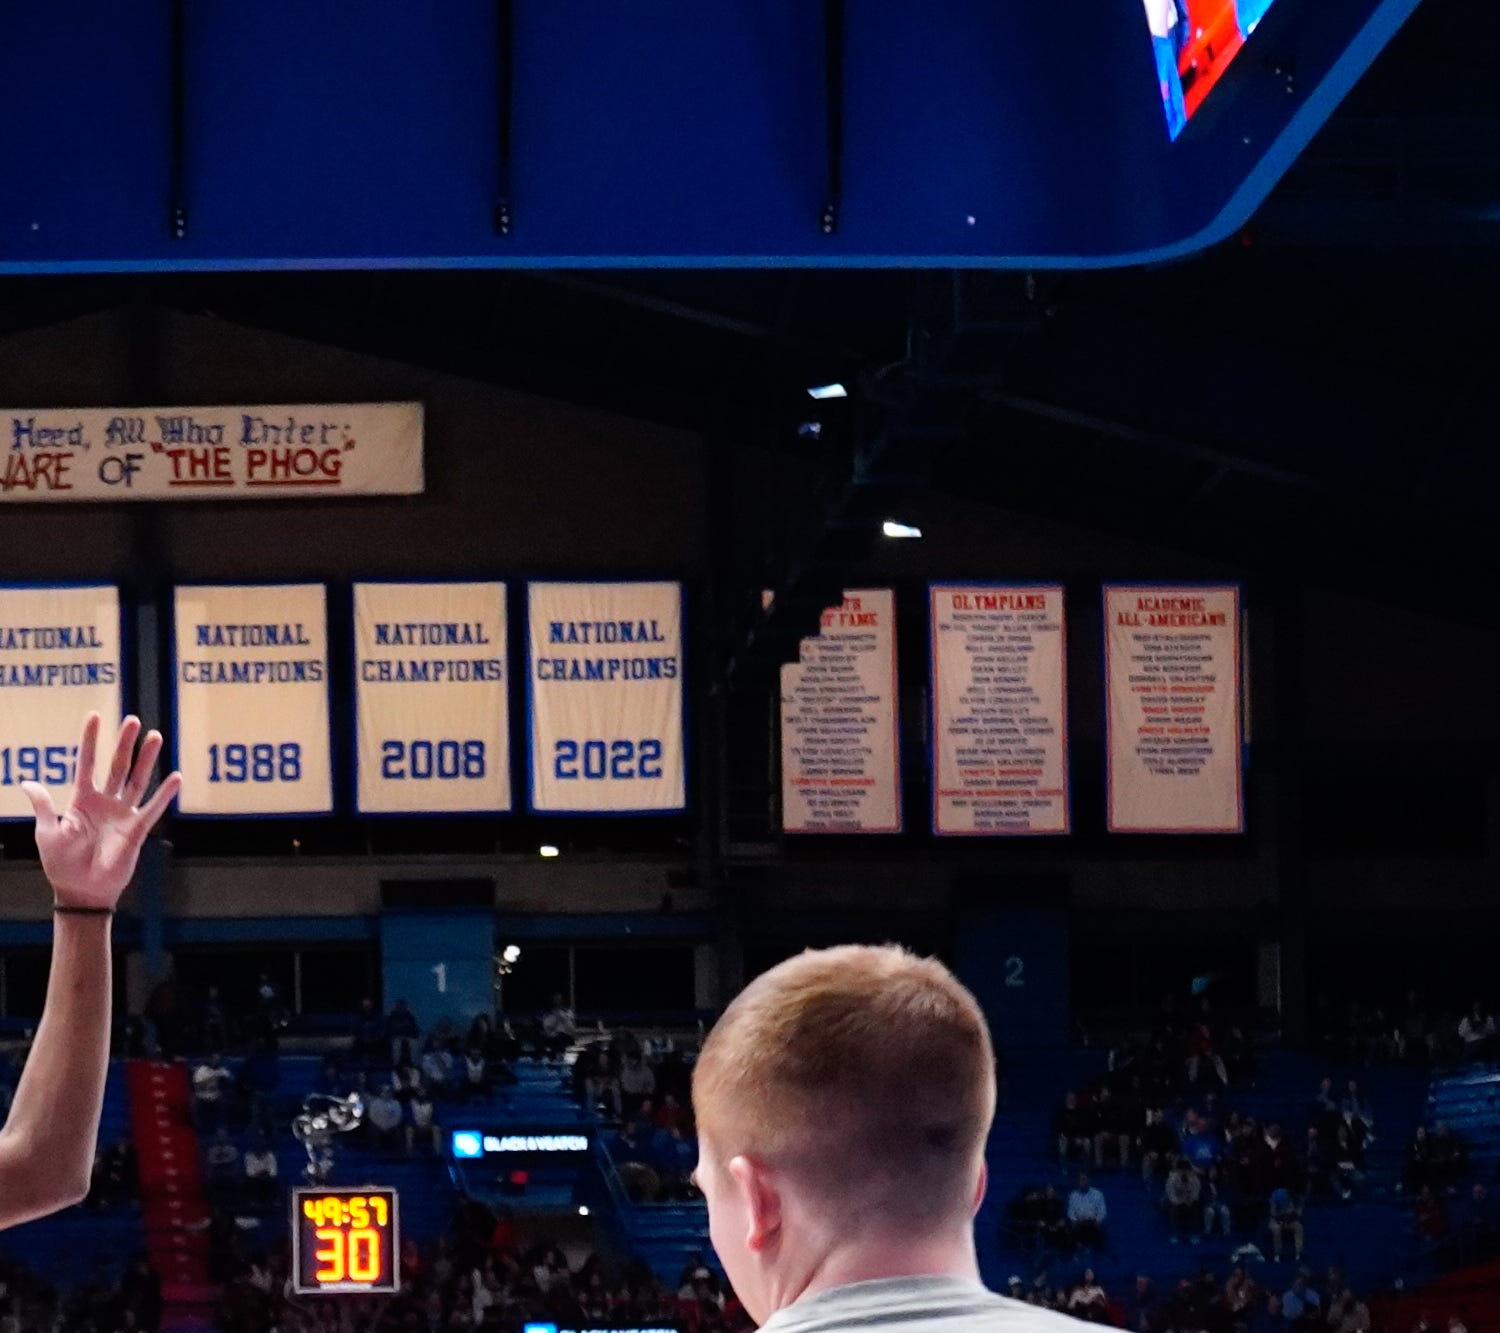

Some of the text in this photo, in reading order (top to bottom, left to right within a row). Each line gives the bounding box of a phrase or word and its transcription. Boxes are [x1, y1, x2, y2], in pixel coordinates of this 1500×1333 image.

[11, 416, 90, 450] Heed,
[105, 416, 146, 447] All
[155, 415, 226, 445] Who
[100, 453, 146, 488] OF
[952, 594, 1046, 610] OLYMPIANS
[1136, 596, 1206, 612] ACADEMIC
[374, 622, 490, 646] NATIONAL
[549, 620, 665, 644] NATIONAL
[1117, 611, 1226, 627] ALL-AMERICANS
[195, 623, 310, 647] NATIONAL
[182, 660, 323, 684] CHAMPIONS
[361, 659, 501, 683] CHAMPIONS
[536, 656, 678, 681] CHAMPIONS
[0, 744, 79, 786] 195
[208, 742, 302, 783] 1988
[381, 740, 486, 780] 2008
[554, 739, 663, 780] 2022
[431, 961, 446, 992] 1
[1005, 954, 1026, 988] 2
[304, 1196, 389, 1229] 49:57
[314, 1228, 381, 1282] 30
